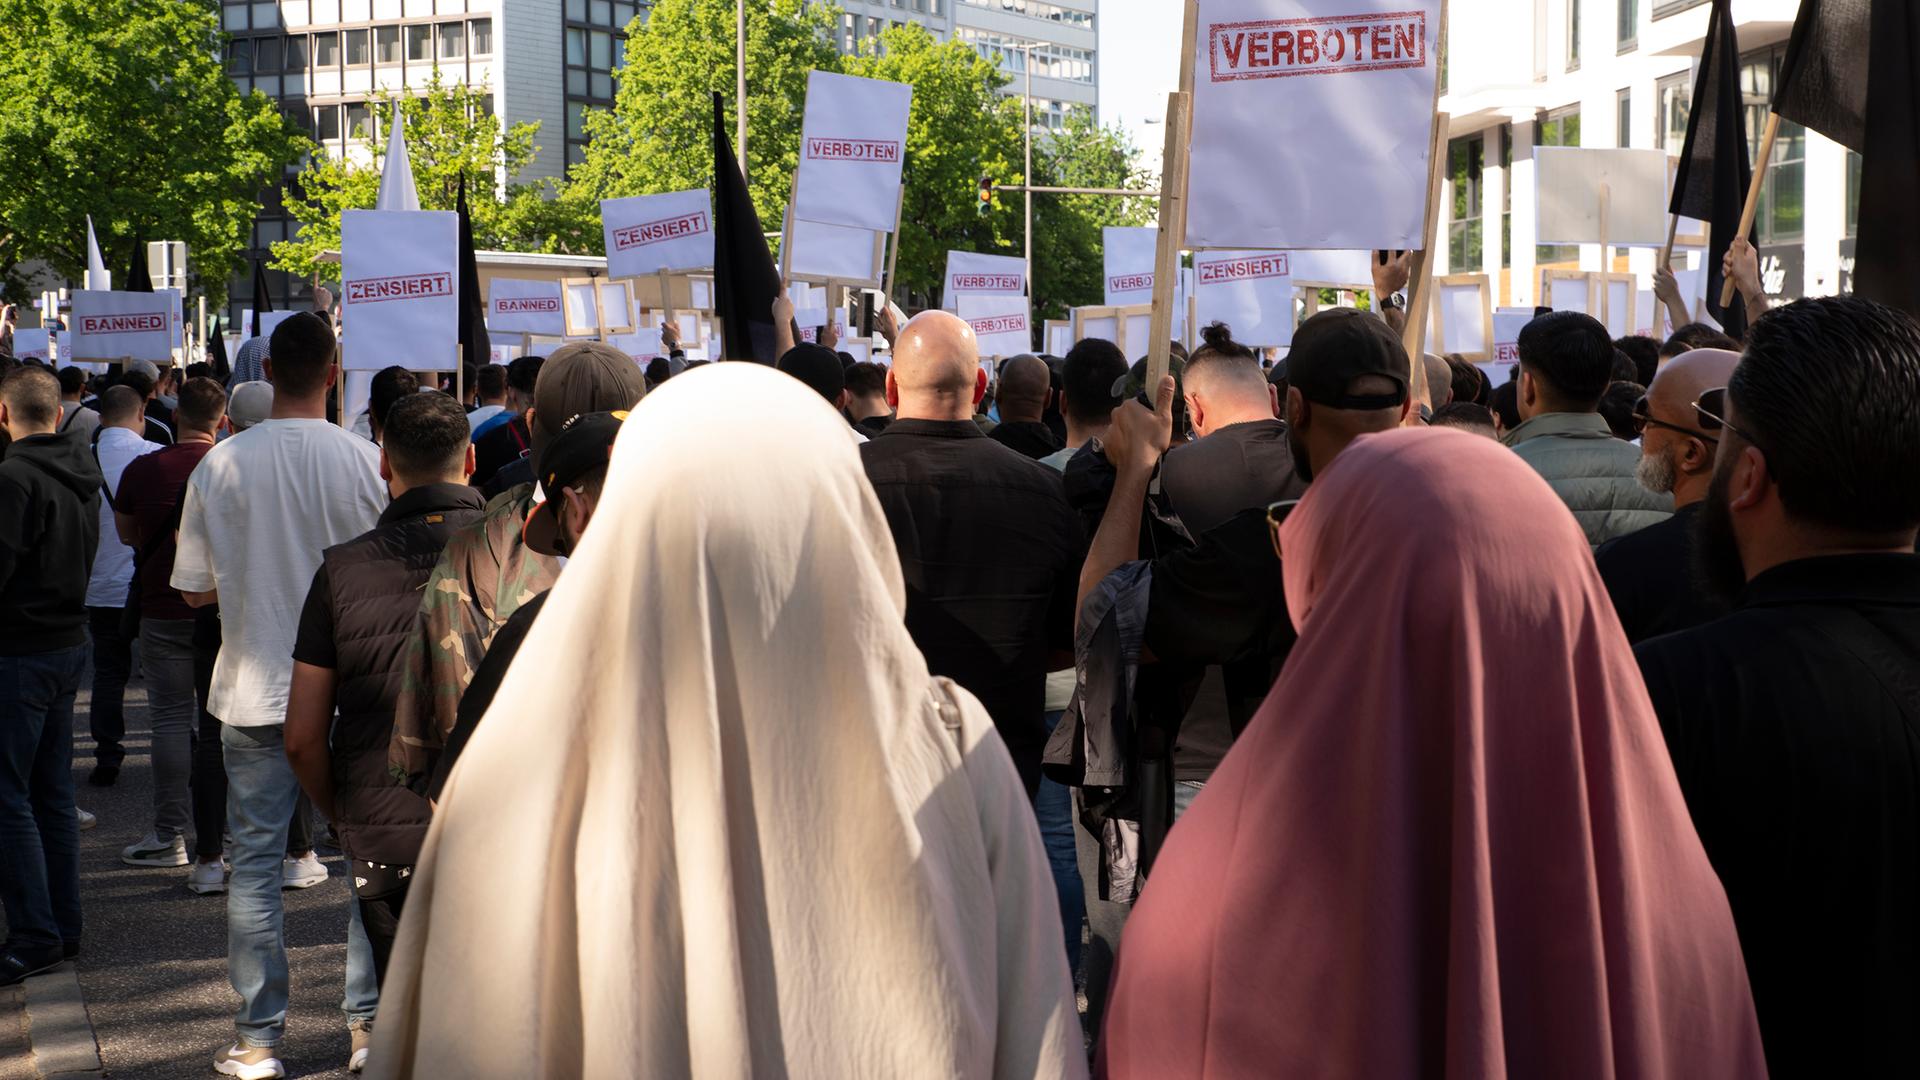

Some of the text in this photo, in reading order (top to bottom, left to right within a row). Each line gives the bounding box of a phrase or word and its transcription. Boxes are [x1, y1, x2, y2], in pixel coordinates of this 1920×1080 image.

[1221, 23, 1415, 68] VERBOTEN
[813, 142, 894, 158] VERBOTEN
[617, 216, 700, 246] ZENSIERT
[1203, 258, 1282, 279] ZENSIERT
[351, 277, 445, 298] ZENSIERT
[956, 276, 1017, 288] VERBOTEN
[1112, 275, 1154, 289] VERBO
[500, 300, 556, 310] BANNED
[85, 316, 162, 331] BANNED
